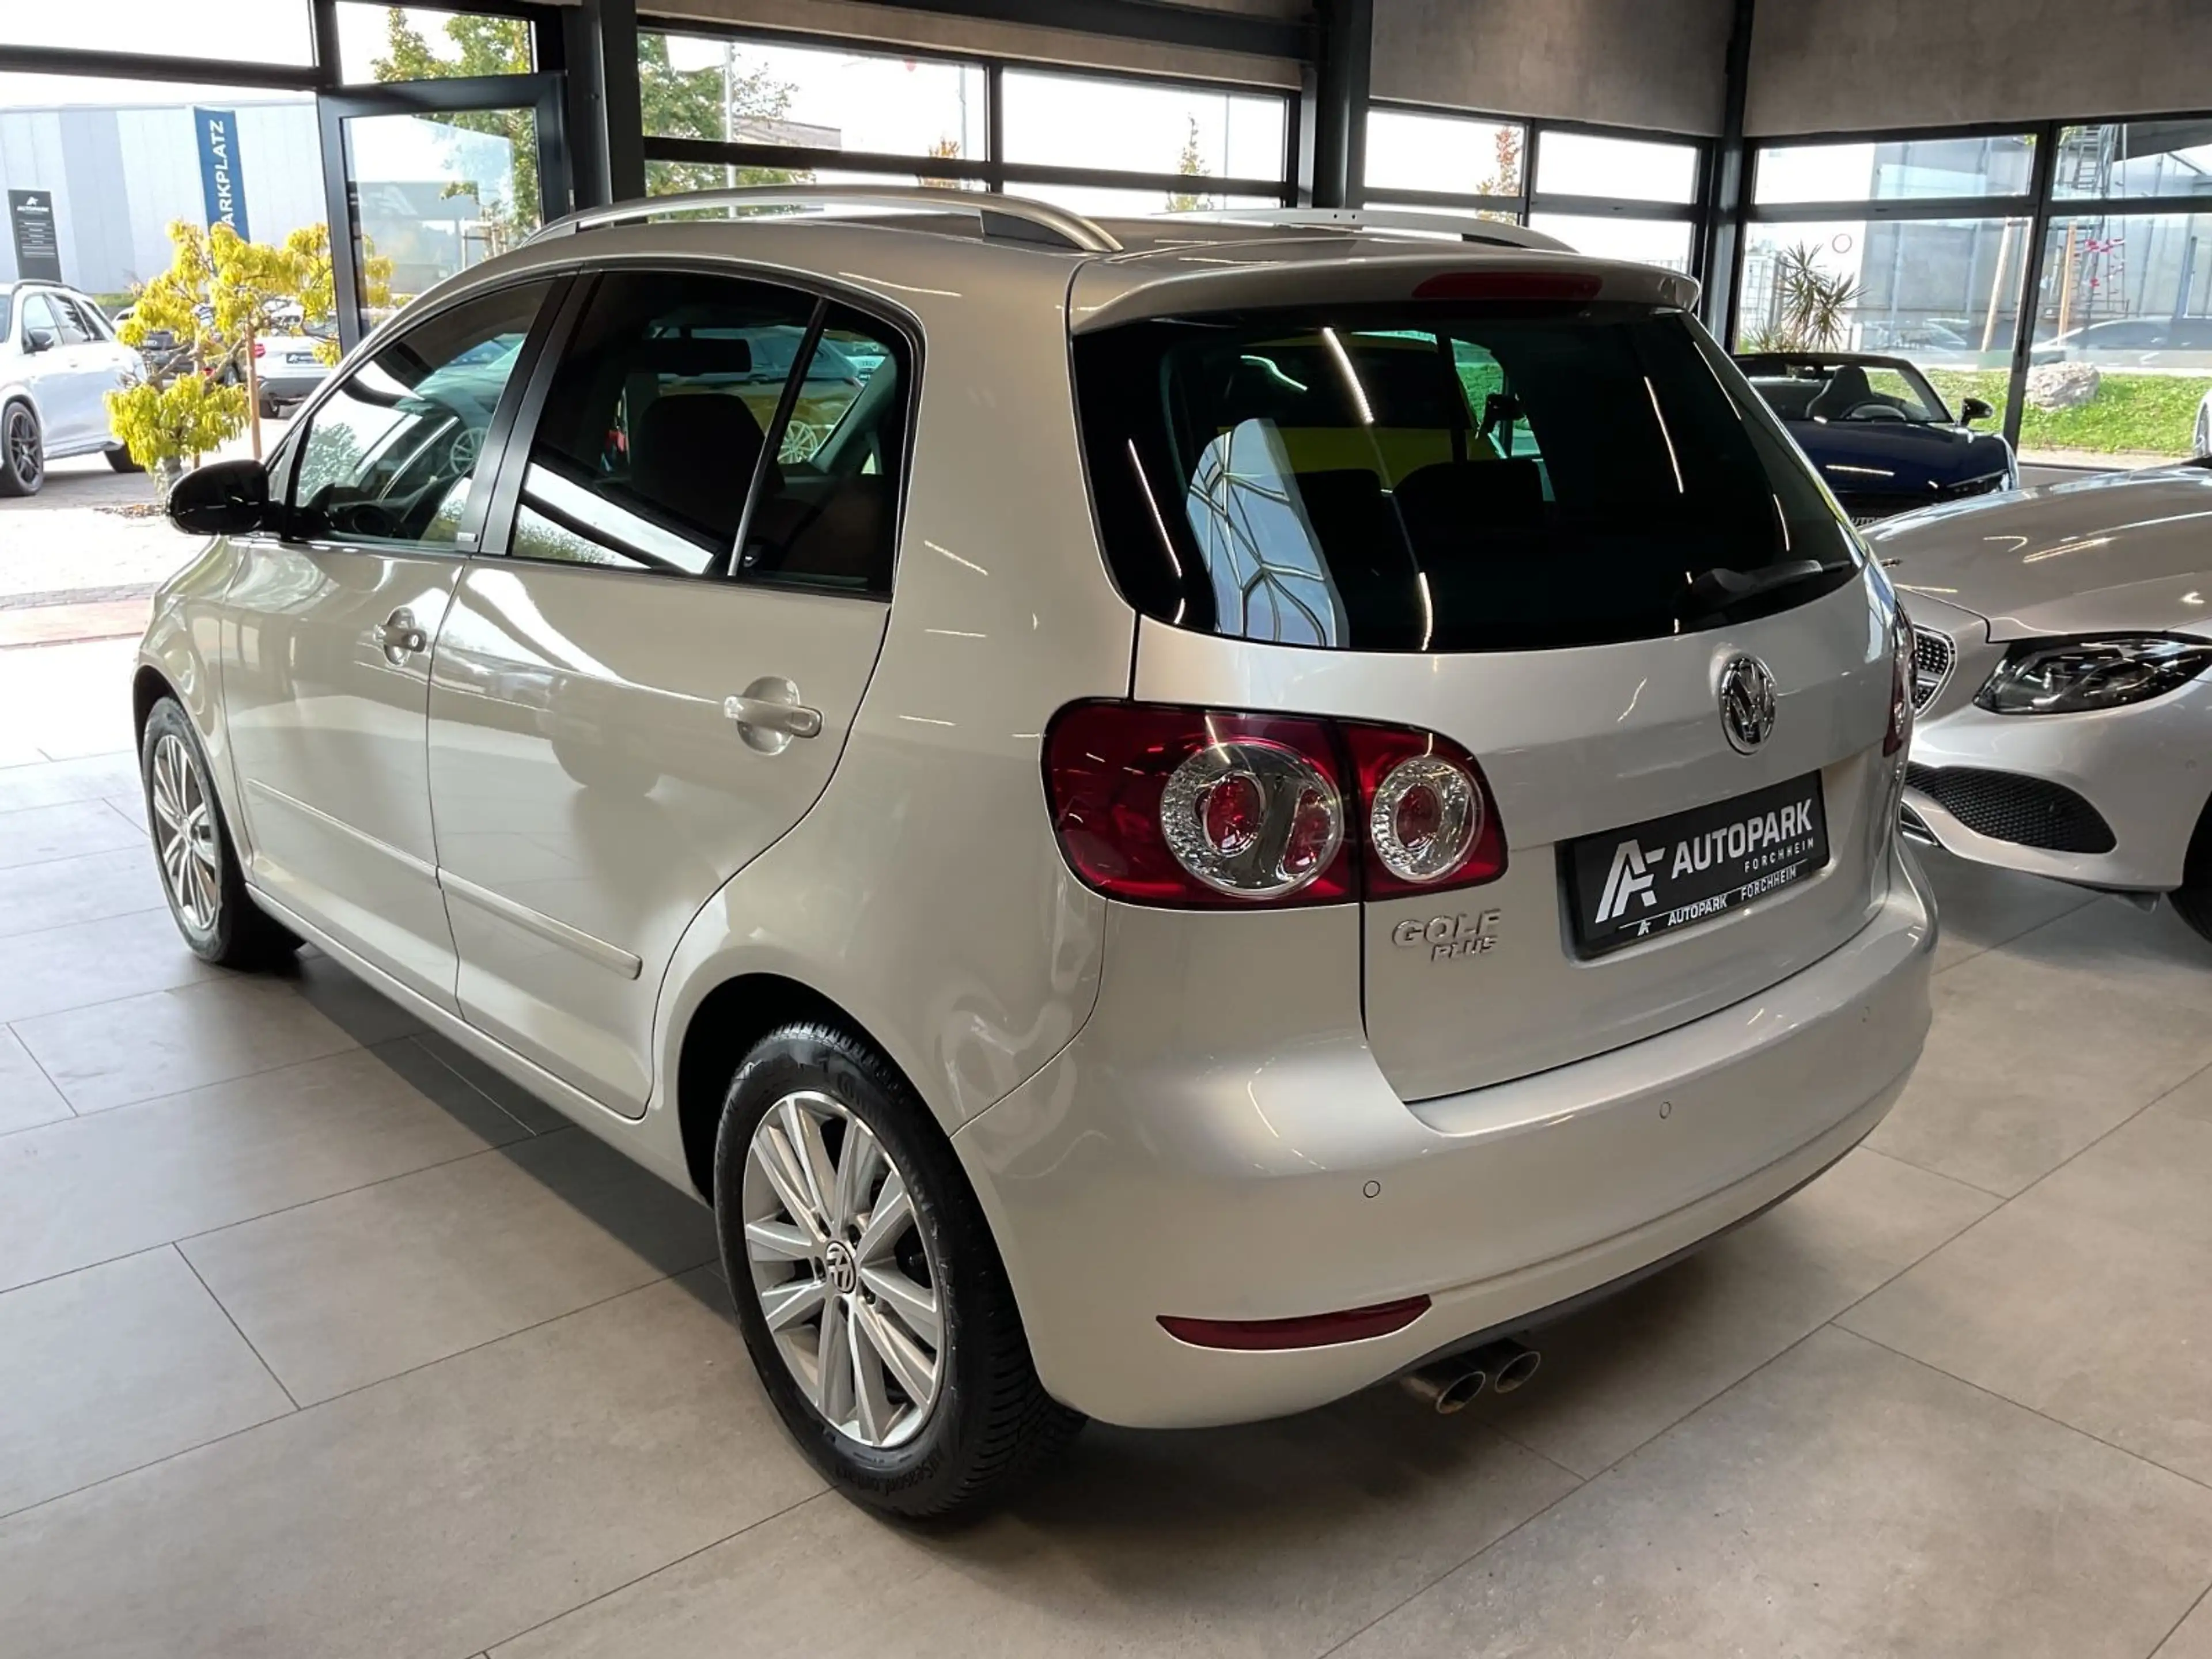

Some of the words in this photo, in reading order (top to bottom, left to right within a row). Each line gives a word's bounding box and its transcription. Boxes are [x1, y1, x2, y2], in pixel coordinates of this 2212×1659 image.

[209, 119, 236, 228] ARKPLATZ
[1671, 798, 1812, 880] AUTOPARK
[1744, 837, 1814, 873] FORCHHEIM
[1668, 894, 1728, 926] AUTOPARK
[1741, 865, 1797, 900] FORCHHEIM
[1392, 908, 1501, 947] GOLF
[1431, 935, 1499, 962] PLUS
